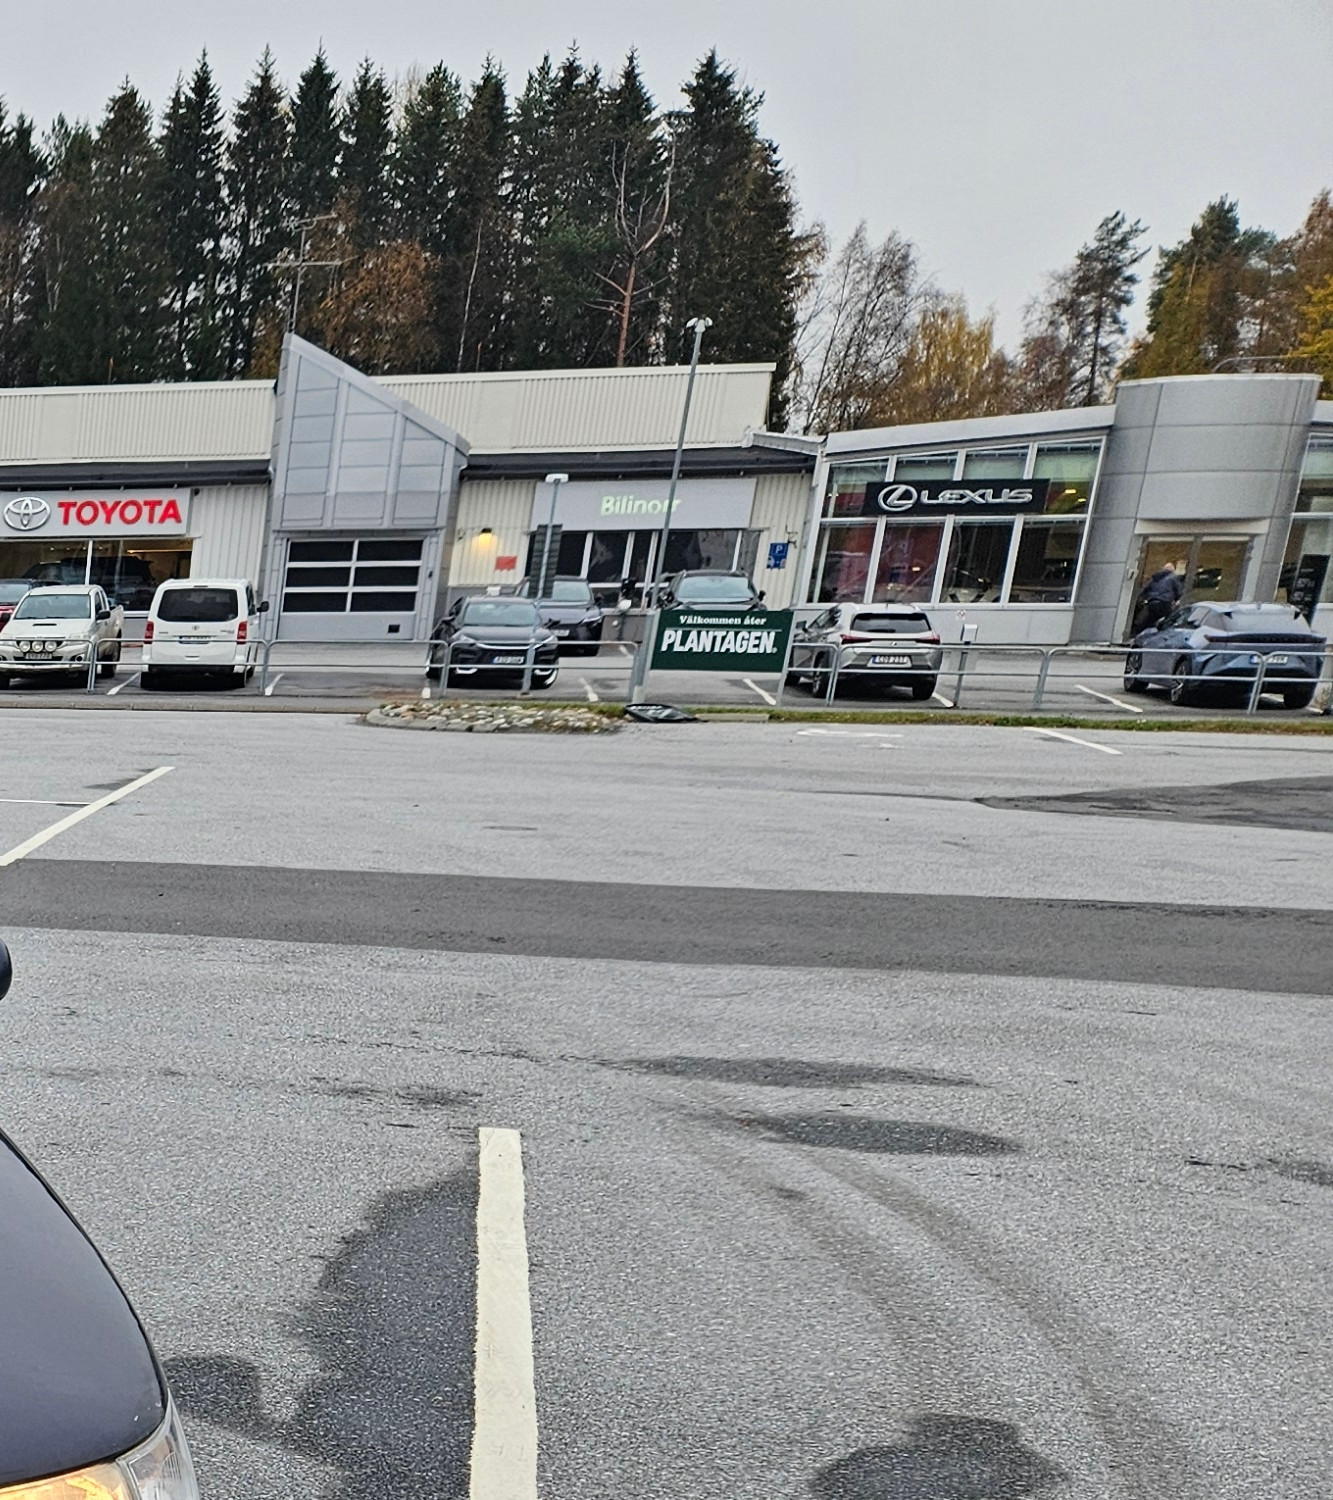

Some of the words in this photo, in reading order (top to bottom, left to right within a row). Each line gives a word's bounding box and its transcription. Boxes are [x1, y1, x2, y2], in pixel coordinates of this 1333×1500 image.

[920, 488, 1033, 505] LEXUS
[57, 498, 182, 526] TOYOTA
[678, 614, 742, 625] Välkommen
[743, 614, 767, 625] åter
